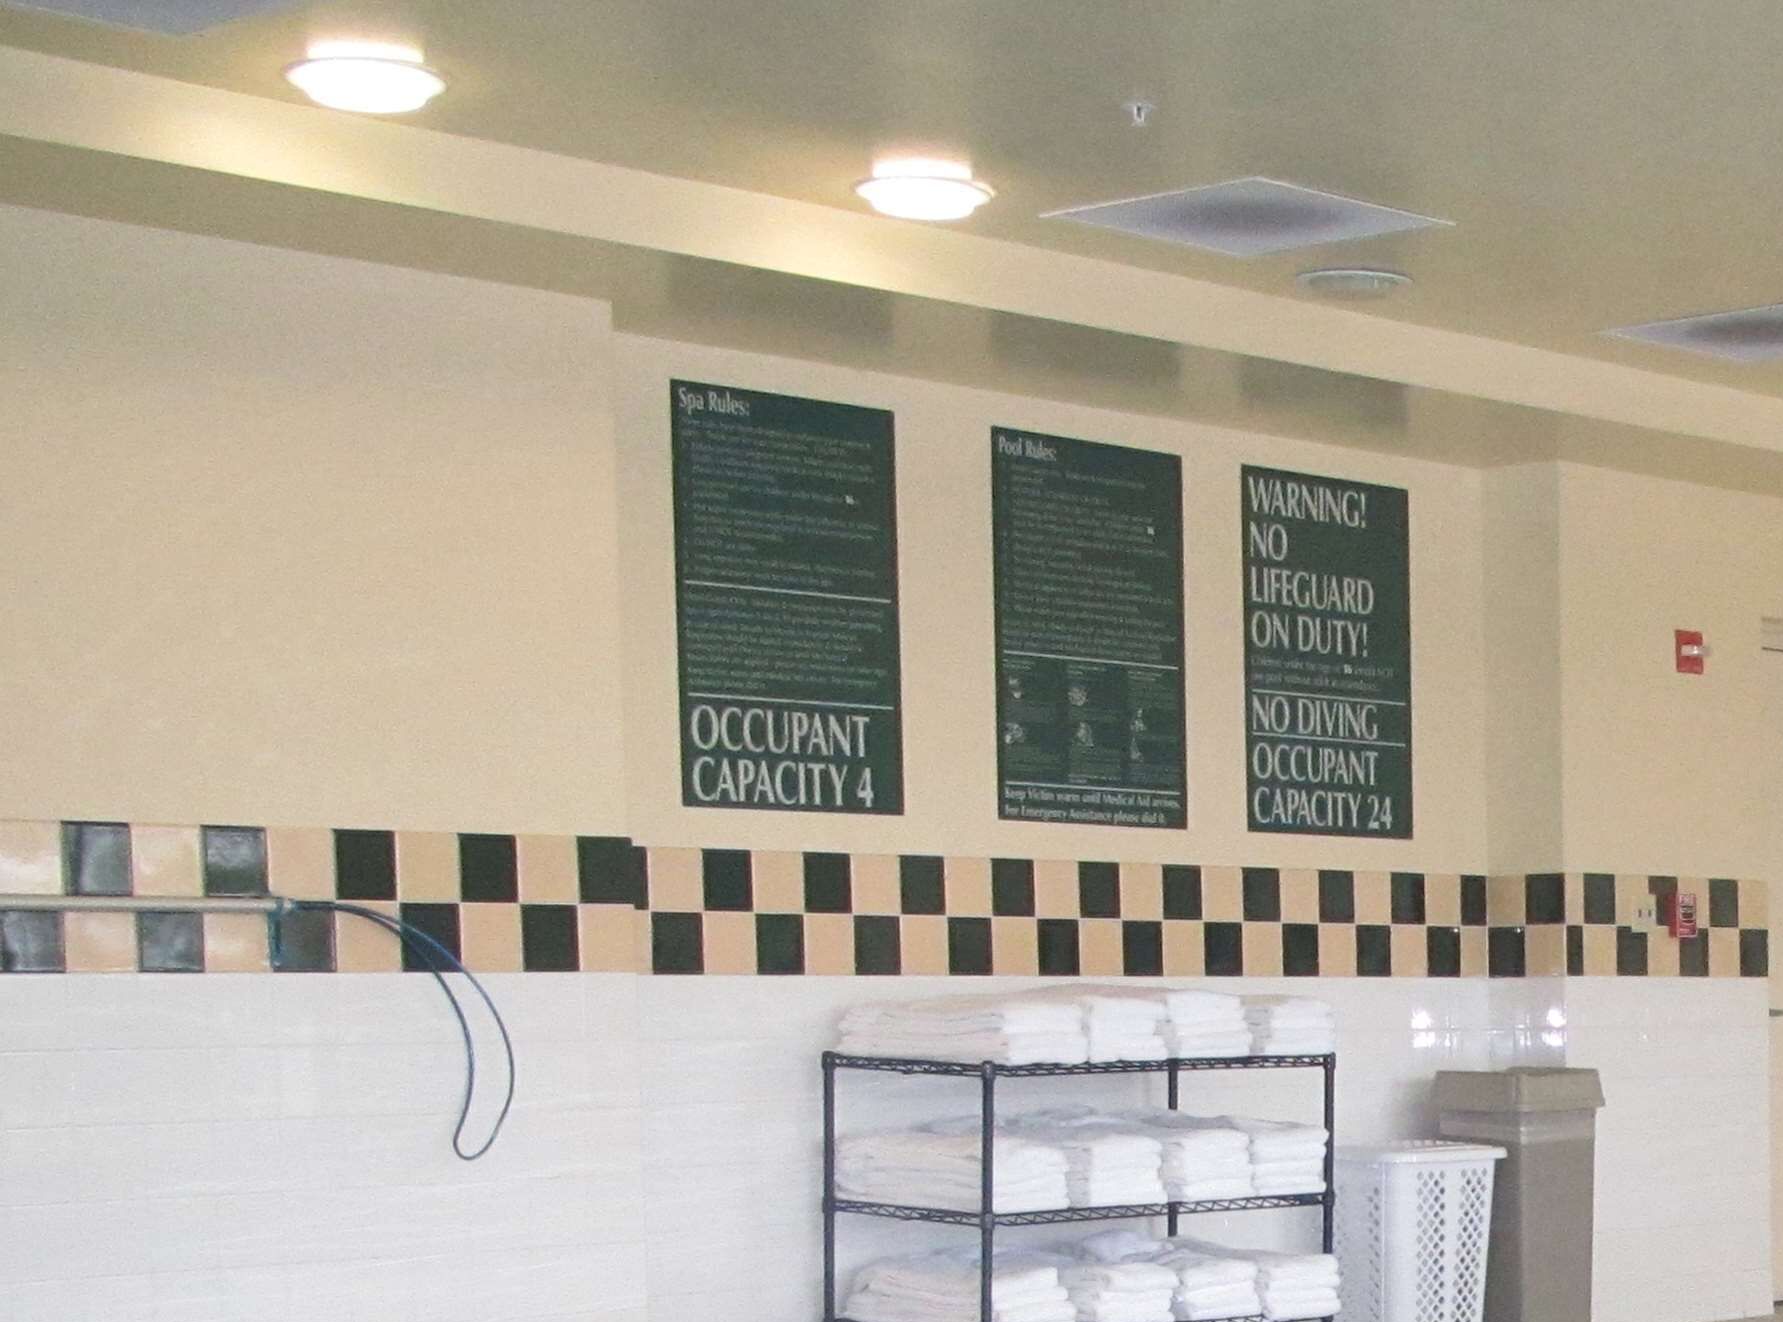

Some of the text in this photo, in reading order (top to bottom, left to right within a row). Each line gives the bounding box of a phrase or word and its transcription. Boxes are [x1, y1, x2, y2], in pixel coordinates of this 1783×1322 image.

[678, 386, 750, 417] Spa Rules:
[998, 434, 1057, 462] Pool Rules:
[1248, 475, 1367, 528] WARNING!
[1250, 521, 1288, 561] NO
[1251, 566, 1374, 615] LIFEGUARD
[1252, 611, 1369, 657] ON DUTY!
[691, 704, 870, 757] OCCUPANT
[1252, 694, 1378, 740] NO DIVING
[692, 755, 875, 808] CAPACITY 4
[1253, 742, 1379, 786] OCCUPANT
[1254, 787, 1393, 829] CAPACITY 24
